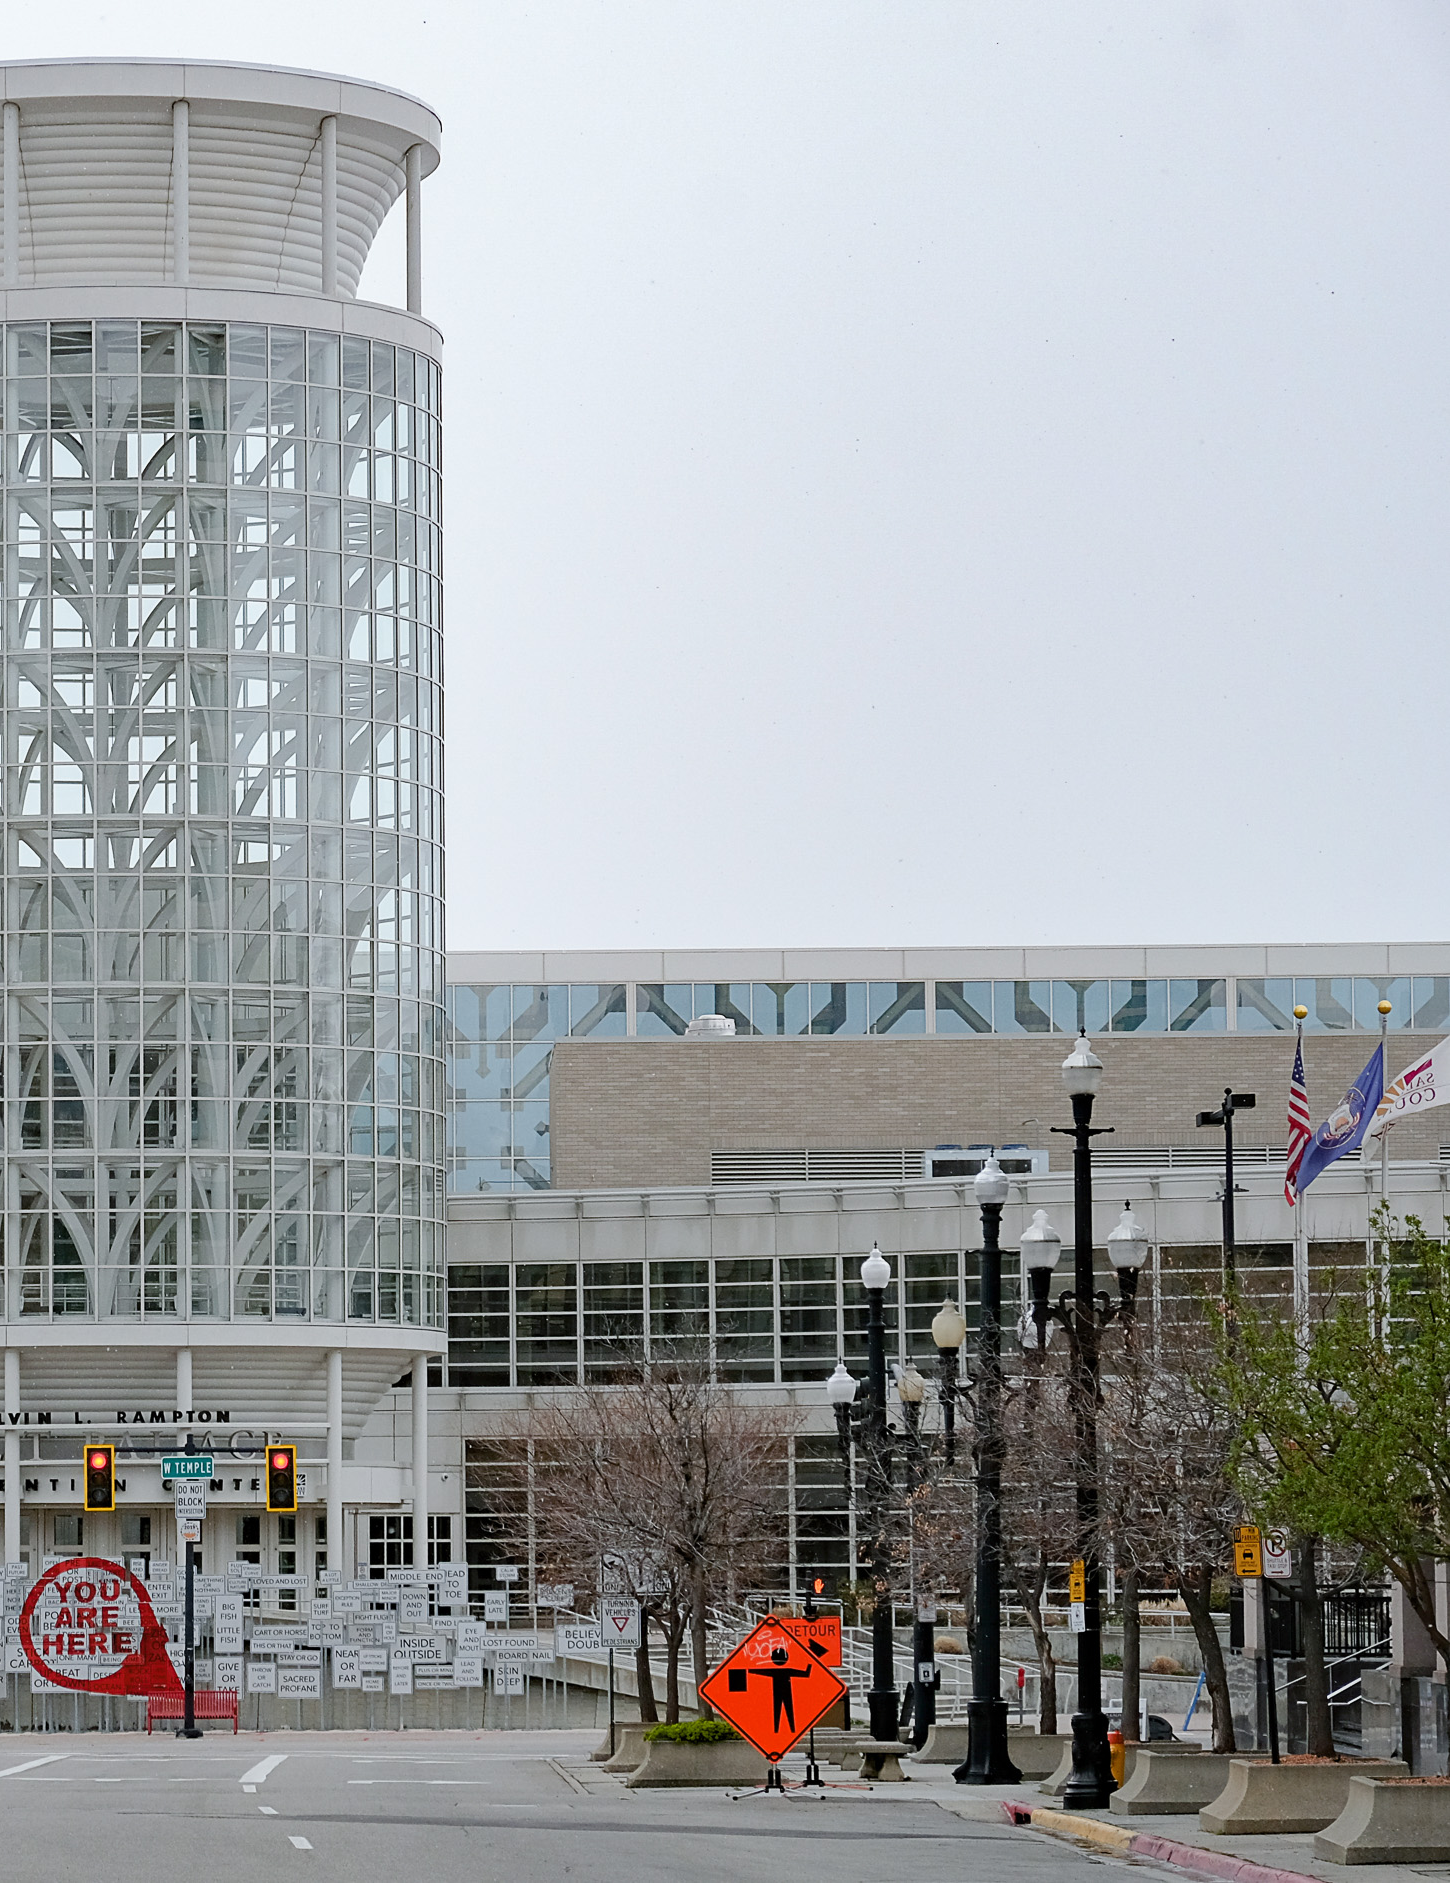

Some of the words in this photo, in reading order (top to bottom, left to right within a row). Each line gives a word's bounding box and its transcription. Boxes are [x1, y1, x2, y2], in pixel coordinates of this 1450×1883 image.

[74, 1412, 92, 1424] L.
[117, 1410, 230, 1423] RAMPTON
[164, 1463, 172, 1474] W
[175, 1462, 211, 1474] TEMPLE
[178, 1486, 187, 1494] DO
[190, 1485, 203, 1494] NOT
[178, 1498, 203, 1506] BLOCK
[389, 1573, 421, 1581] MIDDLE
[53, 1581, 121, 1603] YOU
[445, 1590, 463, 1598] TOE
[222, 1603, 236, 1611] BIG
[54, 1606, 119, 1629] ARE
[220, 1613, 237, 1621] FISH
[42, 1632, 132, 1655] HERE
[400, 1639, 436, 1648] INSIDE
[335, 1650, 359, 1658] NEAR
[394, 1650, 442, 1659] OUTSIDE
[498, 1652, 528, 1660] BOARD
[218, 1662, 239, 1671] GIVE
[340, 1662, 355, 1670] OR
[497, 1667, 519, 1675] SKIN
[221, 1675, 236, 1683] OR
[283, 1675, 316, 1683] SACRED
[338, 1675, 357, 1683] FAR
[496, 1678, 521, 1686] DEEP
[34, 1679, 49, 1688] OR
[51, 1679, 86, 1688] DOWN
